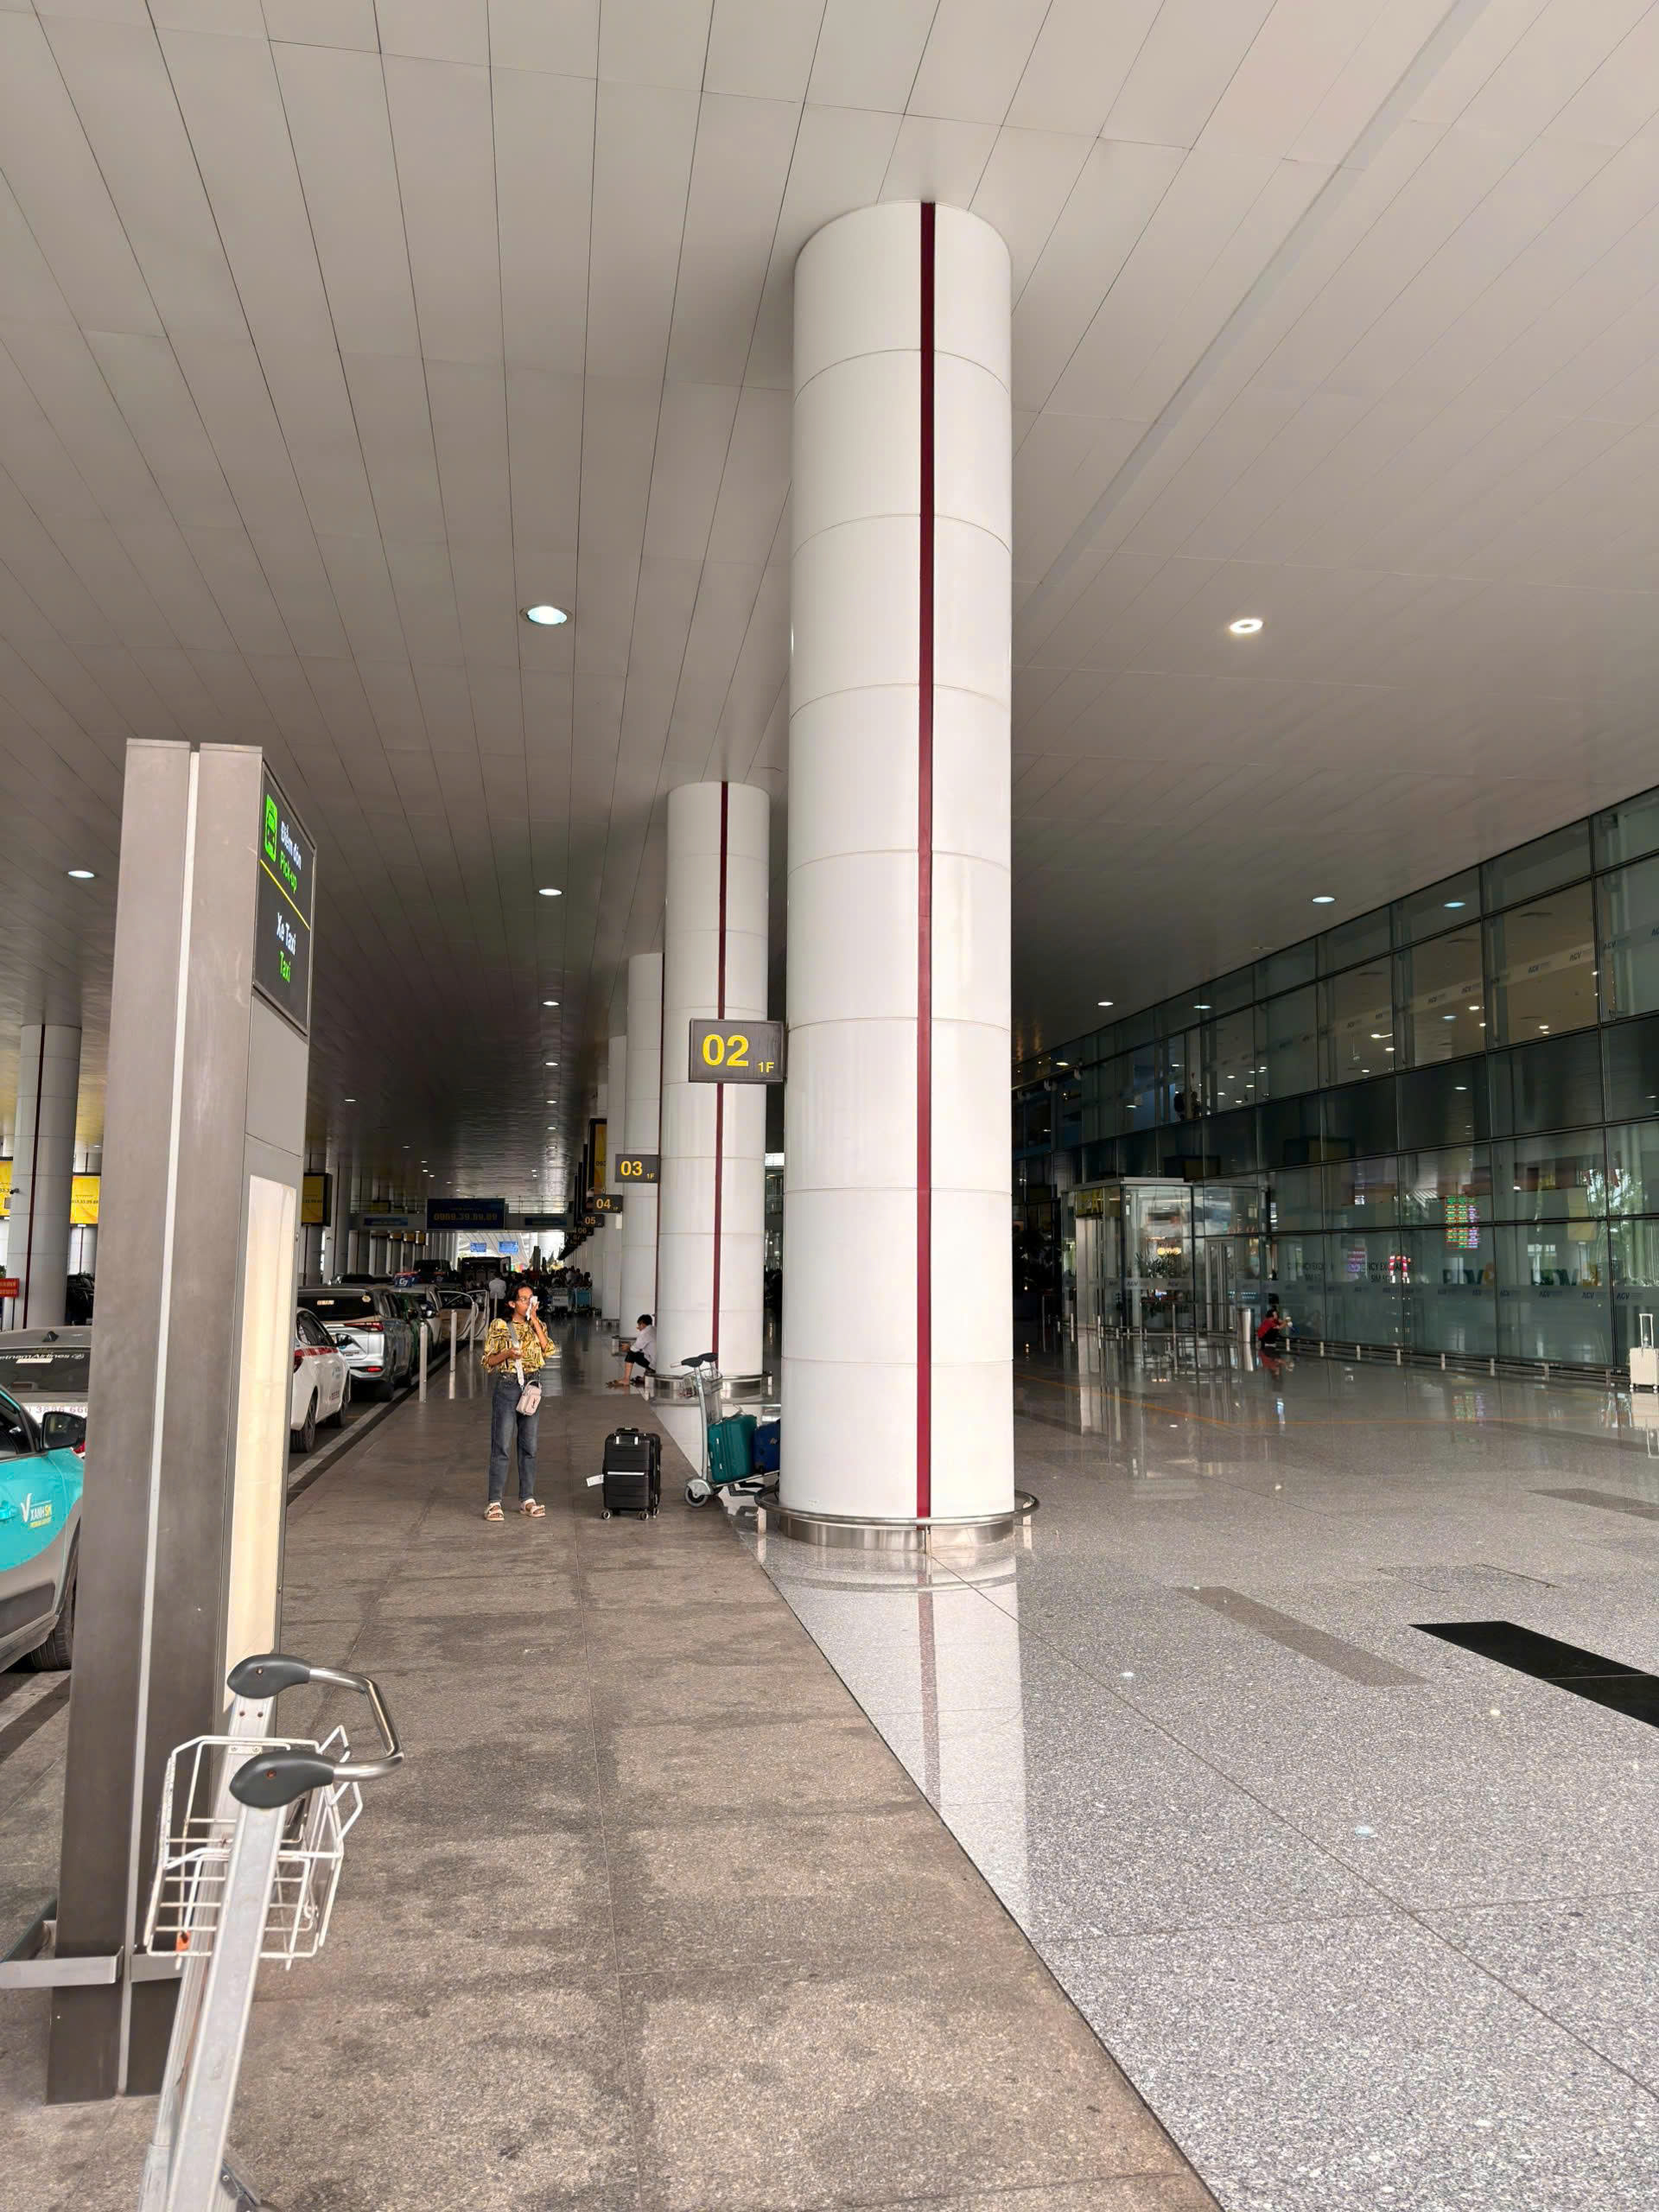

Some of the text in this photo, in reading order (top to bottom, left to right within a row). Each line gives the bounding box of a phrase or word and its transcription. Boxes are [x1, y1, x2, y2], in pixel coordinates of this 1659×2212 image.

[280, 850, 297, 894] Pick-up
[276, 912, 296, 956] Xe Taxi
[280, 950, 291, 983] Taxi
[702, 1034, 775, 1073] 02 1F
[620, 1160, 643, 1176] 03
[596, 1198, 611, 1209] 04
